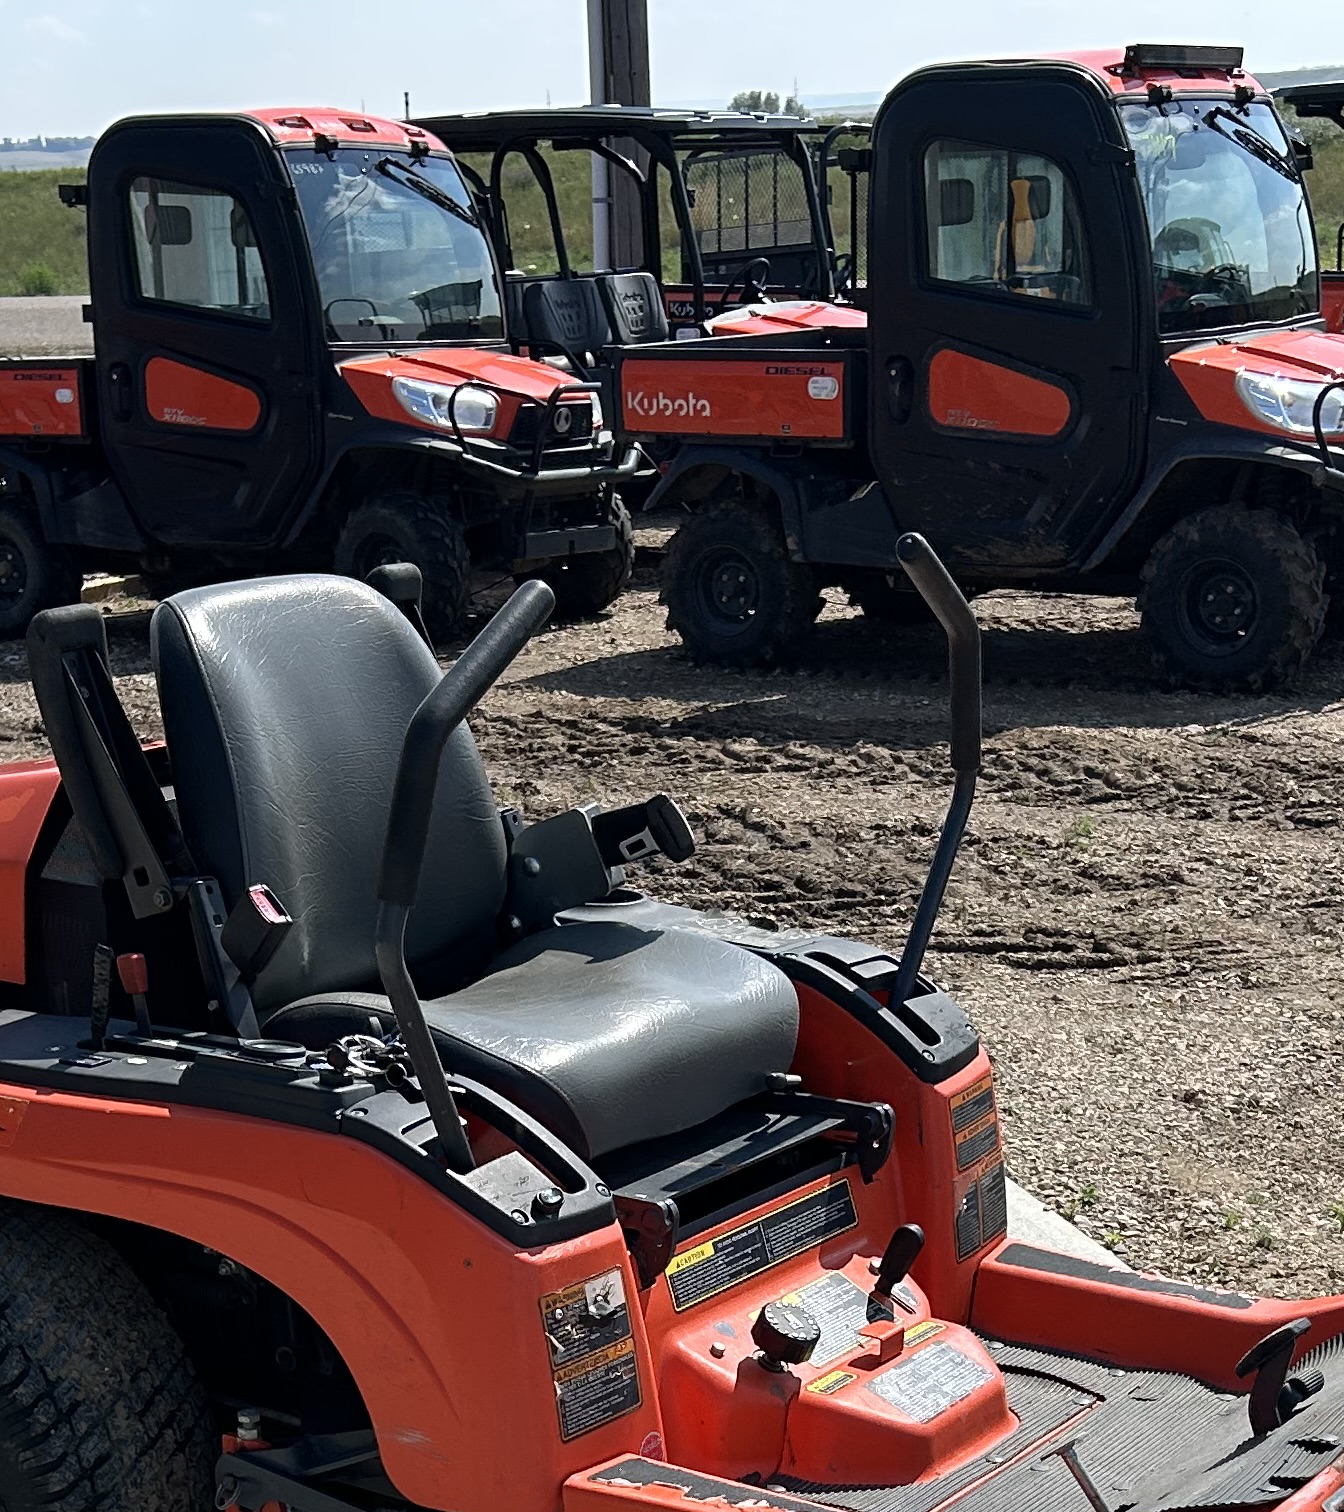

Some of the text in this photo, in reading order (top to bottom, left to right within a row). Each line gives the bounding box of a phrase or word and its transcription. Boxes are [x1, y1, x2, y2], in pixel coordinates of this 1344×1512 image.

[13, 373, 68, 381] DIESEL
[765, 366, 832, 375] DIESEL
[627, 391, 711, 417] Kubota
[679, 1249, 706, 1268] CAUTION
